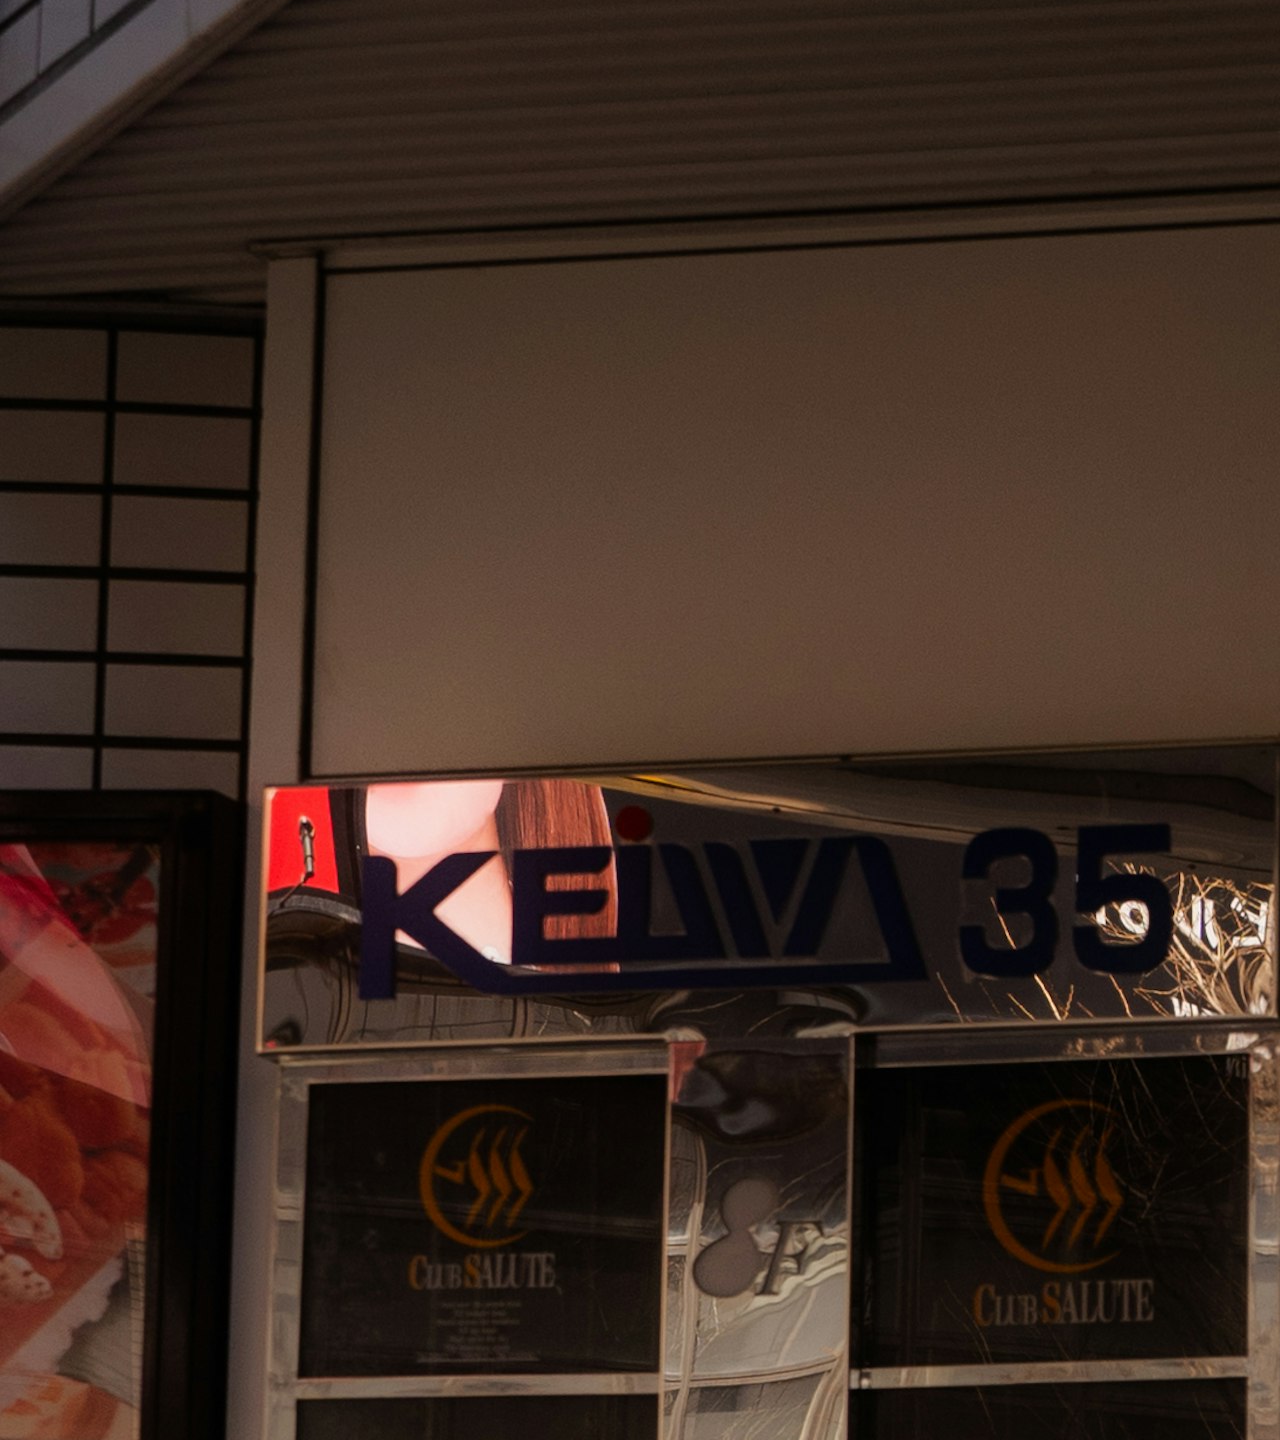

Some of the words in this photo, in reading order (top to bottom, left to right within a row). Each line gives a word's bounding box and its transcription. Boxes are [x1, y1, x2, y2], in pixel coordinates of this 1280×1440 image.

[359, 806, 929, 999] KEIWA
[958, 822, 1172, 978] 35
[692, 1176, 832, 1299] 8F
